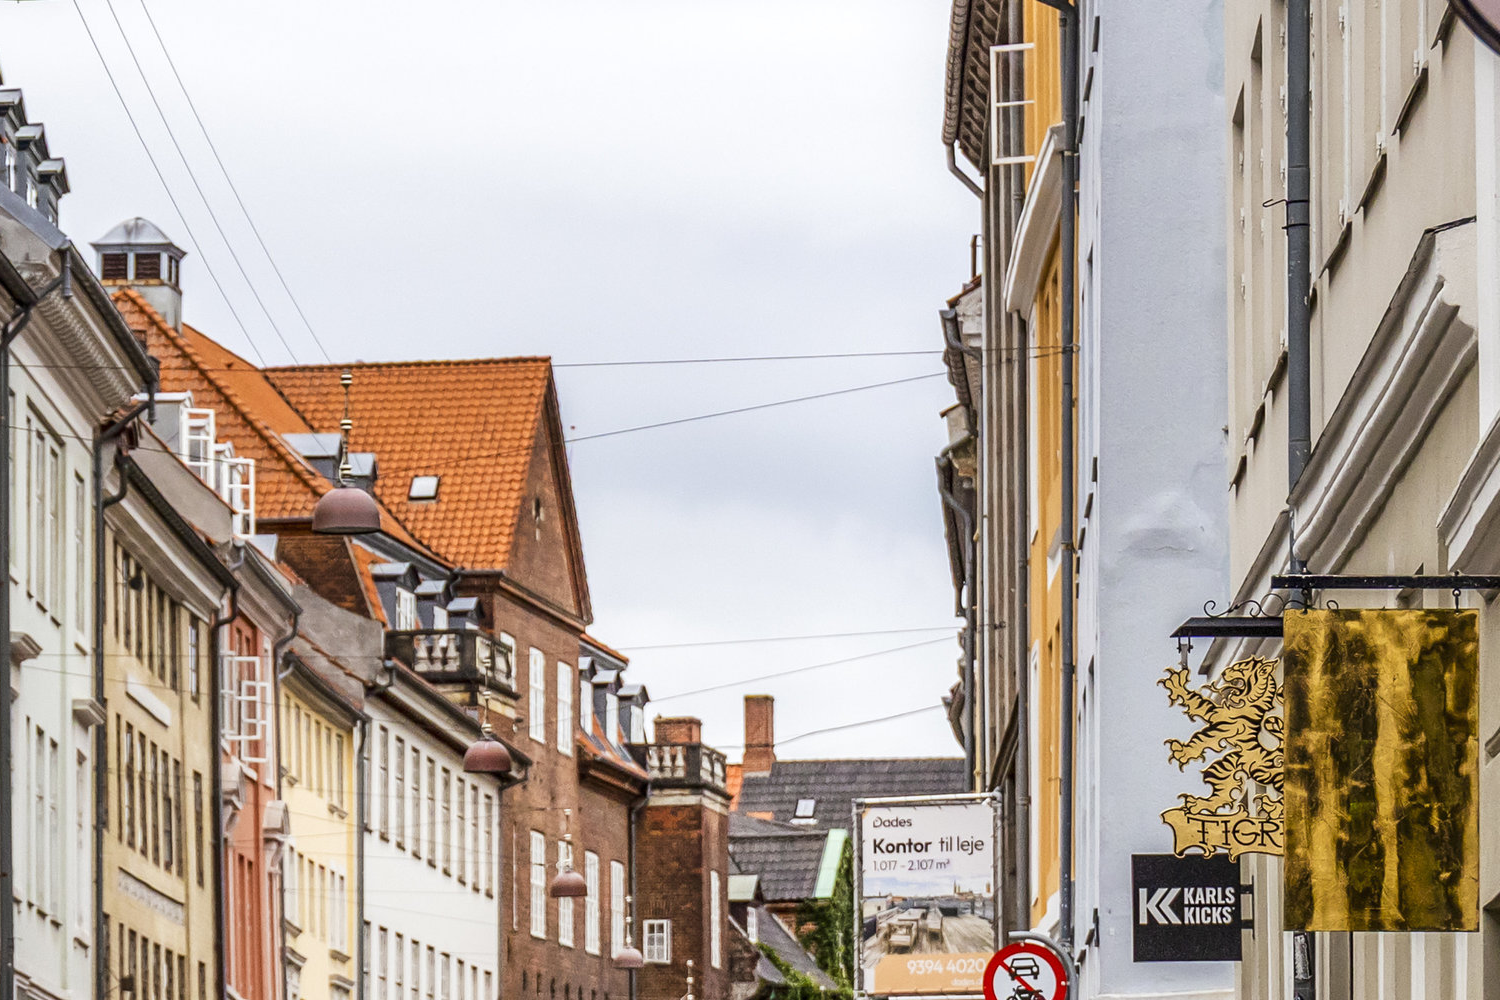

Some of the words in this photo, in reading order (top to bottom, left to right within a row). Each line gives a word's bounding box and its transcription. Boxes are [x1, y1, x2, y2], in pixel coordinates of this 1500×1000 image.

[872, 816, 913, 828] Dades
[1187, 816, 1284, 848] TIGR
[873, 838, 933, 854] Kontor
[938, 836, 953, 852] til
[956, 836, 985, 855] leje
[873, 861, 898, 871] 1.017
[908, 860, 934, 871] 2.107
[1183, 886, 1236, 905] KARLS
[1183, 906, 1232, 925] KICKS
[906, 960, 943, 975] 9394
[946, 958, 986, 974] 4020
